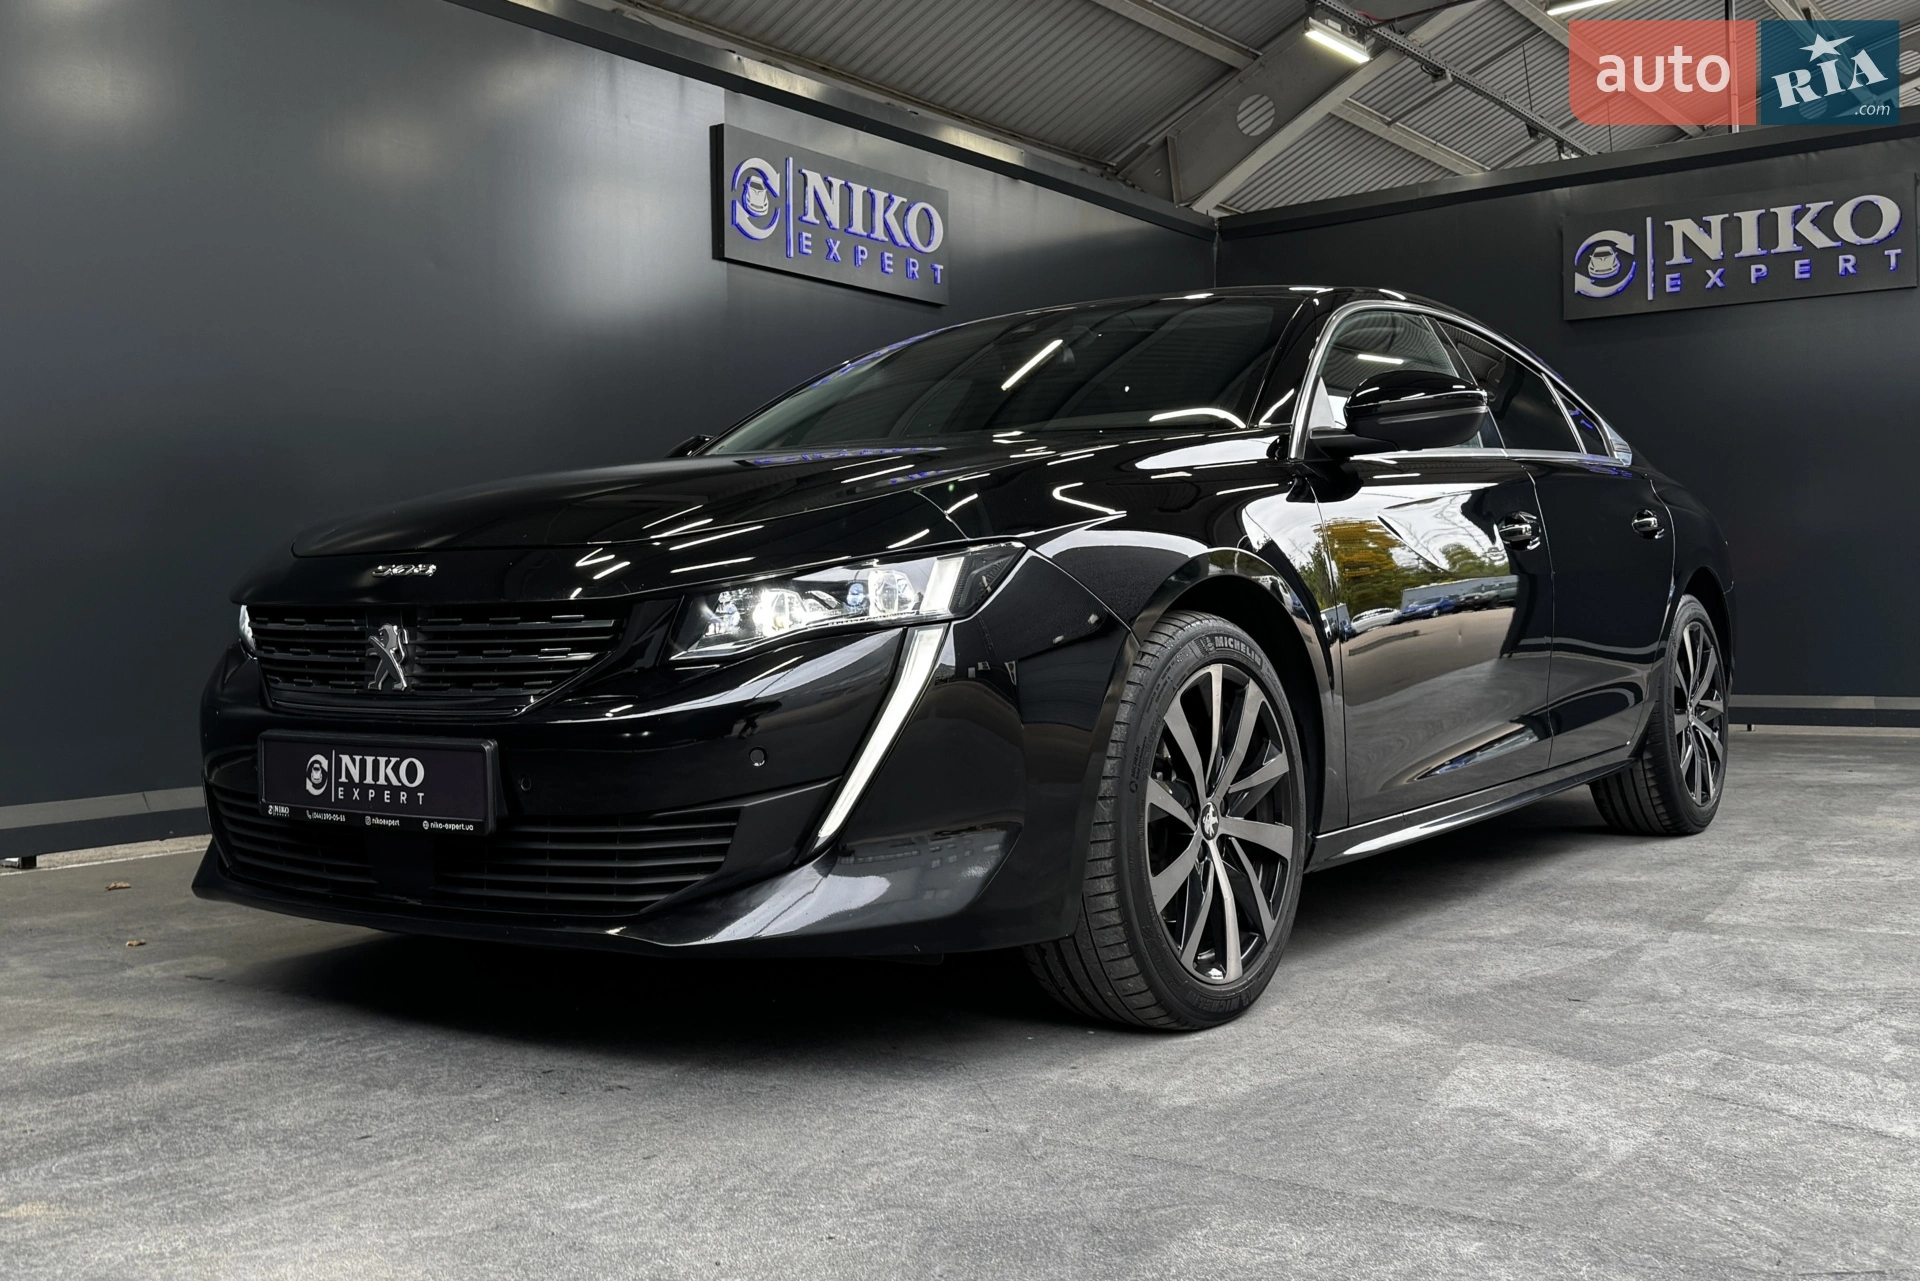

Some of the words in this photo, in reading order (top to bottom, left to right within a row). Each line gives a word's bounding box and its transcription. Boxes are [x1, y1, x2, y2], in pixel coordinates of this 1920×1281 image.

[799, 168, 944, 254] NIKO
[1664, 194, 1903, 266] NIKO
[798, 231, 944, 285] EXPERT
[1665, 248, 1903, 294] EXPERT
[1214, 635, 1263, 667] MICHELIN
[338, 753, 425, 789] NIKO
[338, 786, 425, 806] EXPERT
